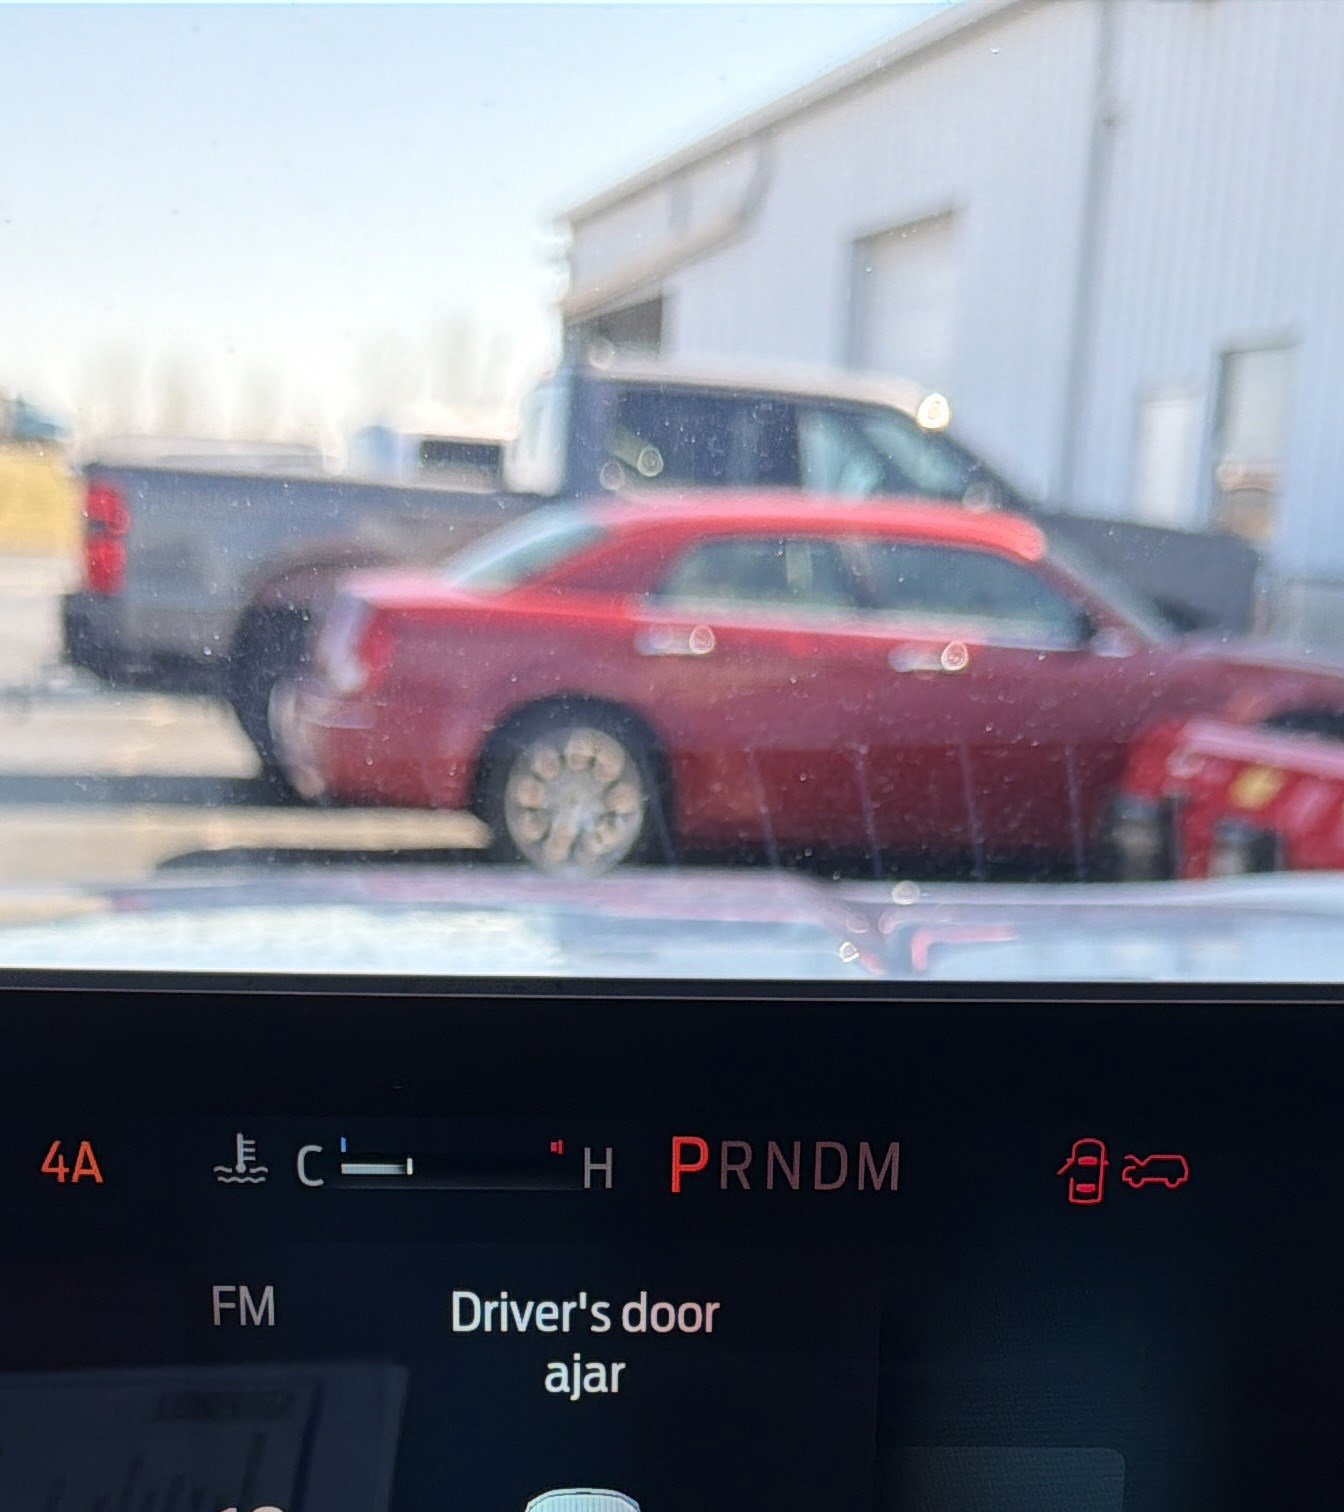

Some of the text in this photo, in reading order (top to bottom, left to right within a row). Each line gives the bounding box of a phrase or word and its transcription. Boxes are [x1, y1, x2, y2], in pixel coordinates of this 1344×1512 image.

[42, 1141, 102, 1182] 4A
[297, 1145, 323, 1186] C
[584, 1148, 612, 1188] H
[213, 1286, 274, 1325] FM
[451, 1290, 721, 1335] Driver's door
[545, 1353, 625, 1400] ajar
